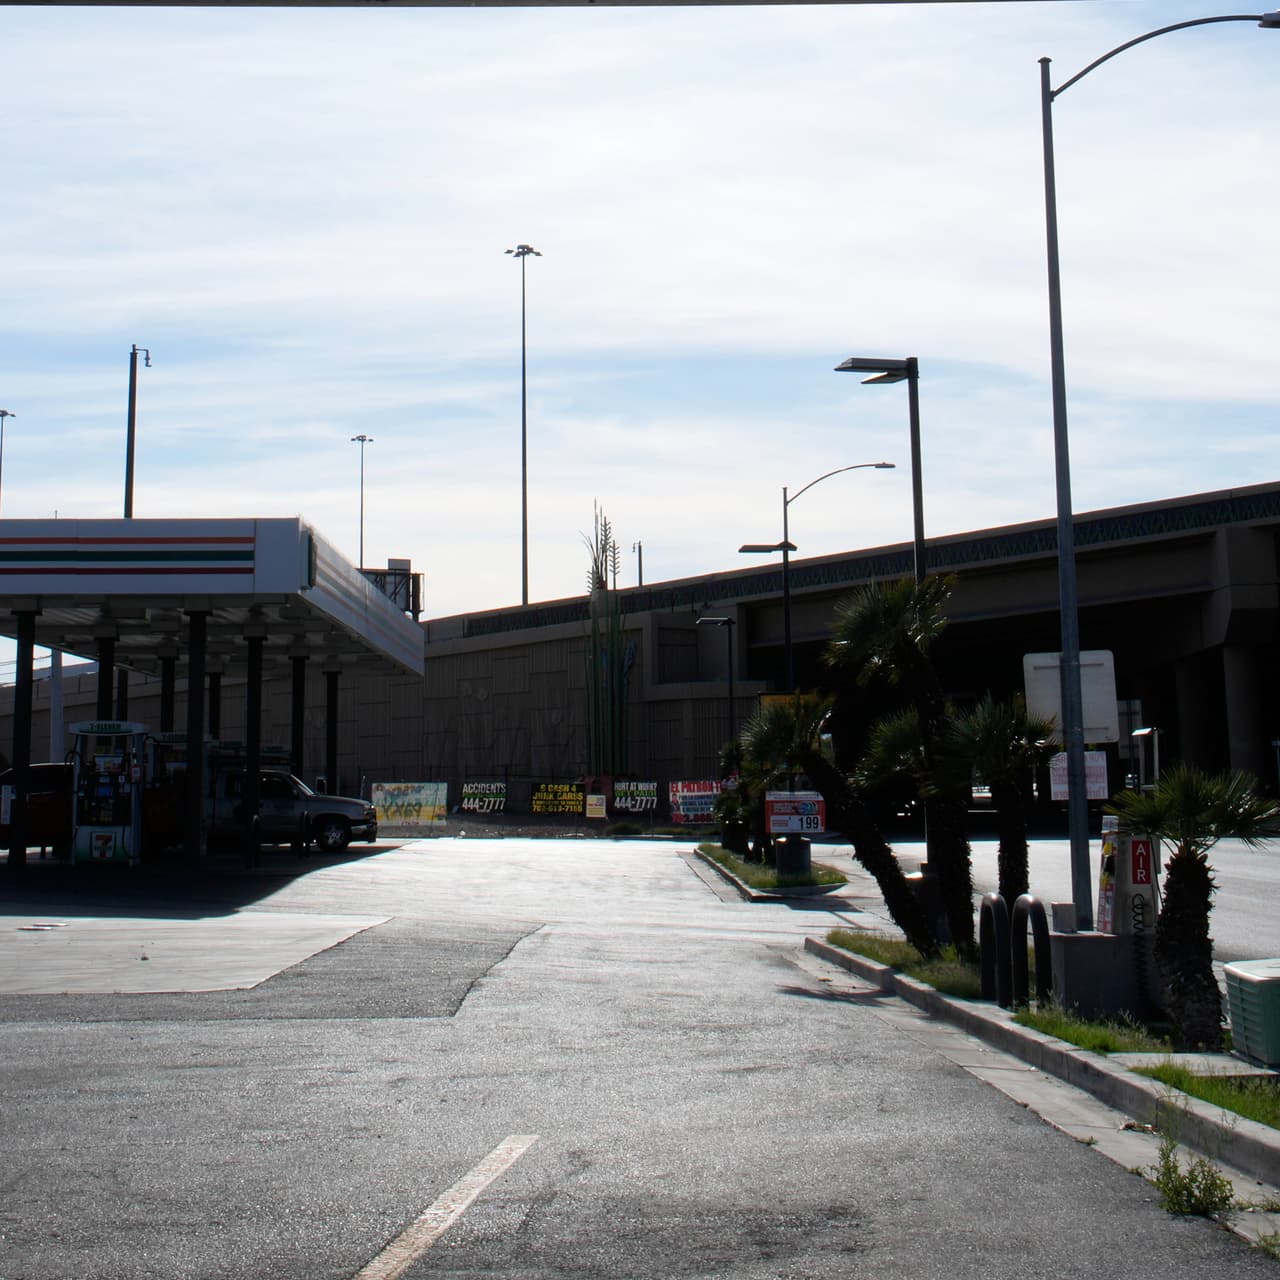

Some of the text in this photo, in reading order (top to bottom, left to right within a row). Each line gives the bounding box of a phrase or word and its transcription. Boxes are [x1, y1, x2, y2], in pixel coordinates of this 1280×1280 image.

[463, 783, 507, 794] ACCIDENTS
[462, 798, 506, 810] 444-7777
[614, 797, 658, 809] 444-7777
[1135, 842, 1147, 882] AIR
